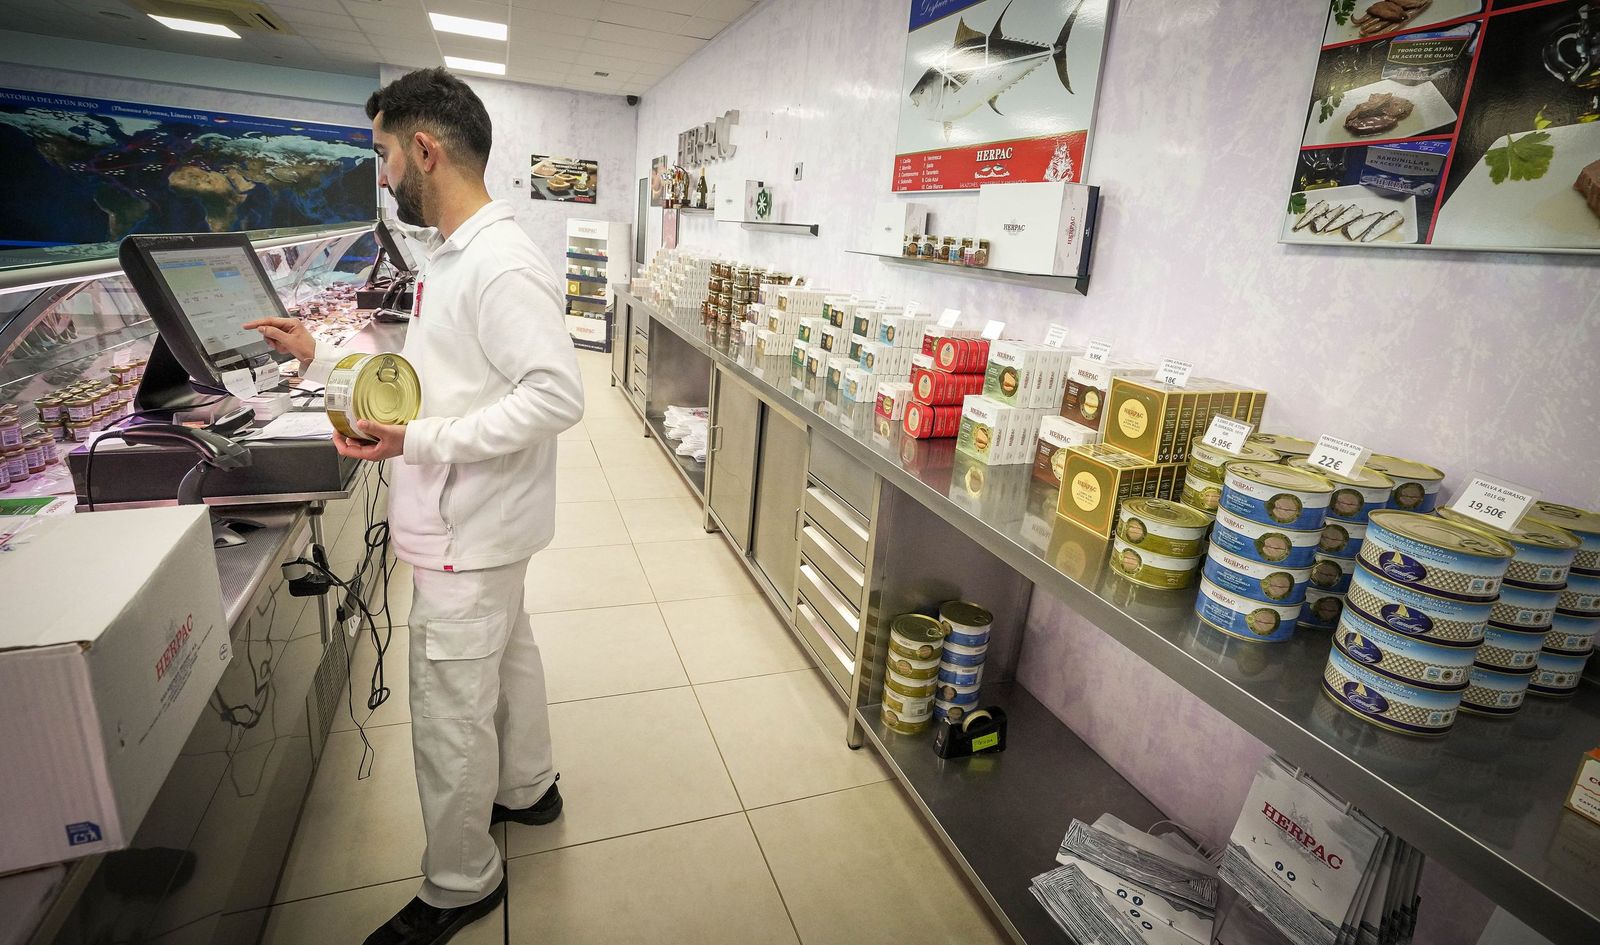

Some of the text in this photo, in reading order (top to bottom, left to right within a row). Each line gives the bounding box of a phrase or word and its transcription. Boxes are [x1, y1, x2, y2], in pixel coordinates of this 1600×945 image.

[78, 100, 99, 109] ROJO
[976, 147, 1013, 162] HERPAC
[1377, 155, 1430, 167] SARDINILLAS
[1003, 223, 1026, 232] HERPAC
[1067, 216, 1076, 245] HERPAC
[996, 351, 1016, 362] HERPAC
[1078, 369, 1099, 380] HERPAC
[1165, 376, 1176, 385] 18€
[1124, 407, 1144, 419] HERPAC
[1049, 430, 1072, 444] HERPAC
[1211, 436, 1233, 450] 9,95€
[1318, 454, 1343, 471] 22€
[1077, 479, 1097, 493] HERPAC
[1232, 479, 1254, 492] HERPAC
[1468, 500, 1507, 519] 19,50€
[1223, 515, 1245, 530] HERPAC
[1414, 546, 1458, 561] CANUTERA
[1417, 543, 1444, 554] MELVA
[1223, 556, 1250, 571] HERPAC
[1211, 590, 1236, 606] HERPAC
[1421, 598, 1463, 612] CANUTERA
[1424, 596, 1451, 606] MELVA
[155, 612, 193, 683] HERPAC
[1262, 801, 1344, 870] HERPAC
